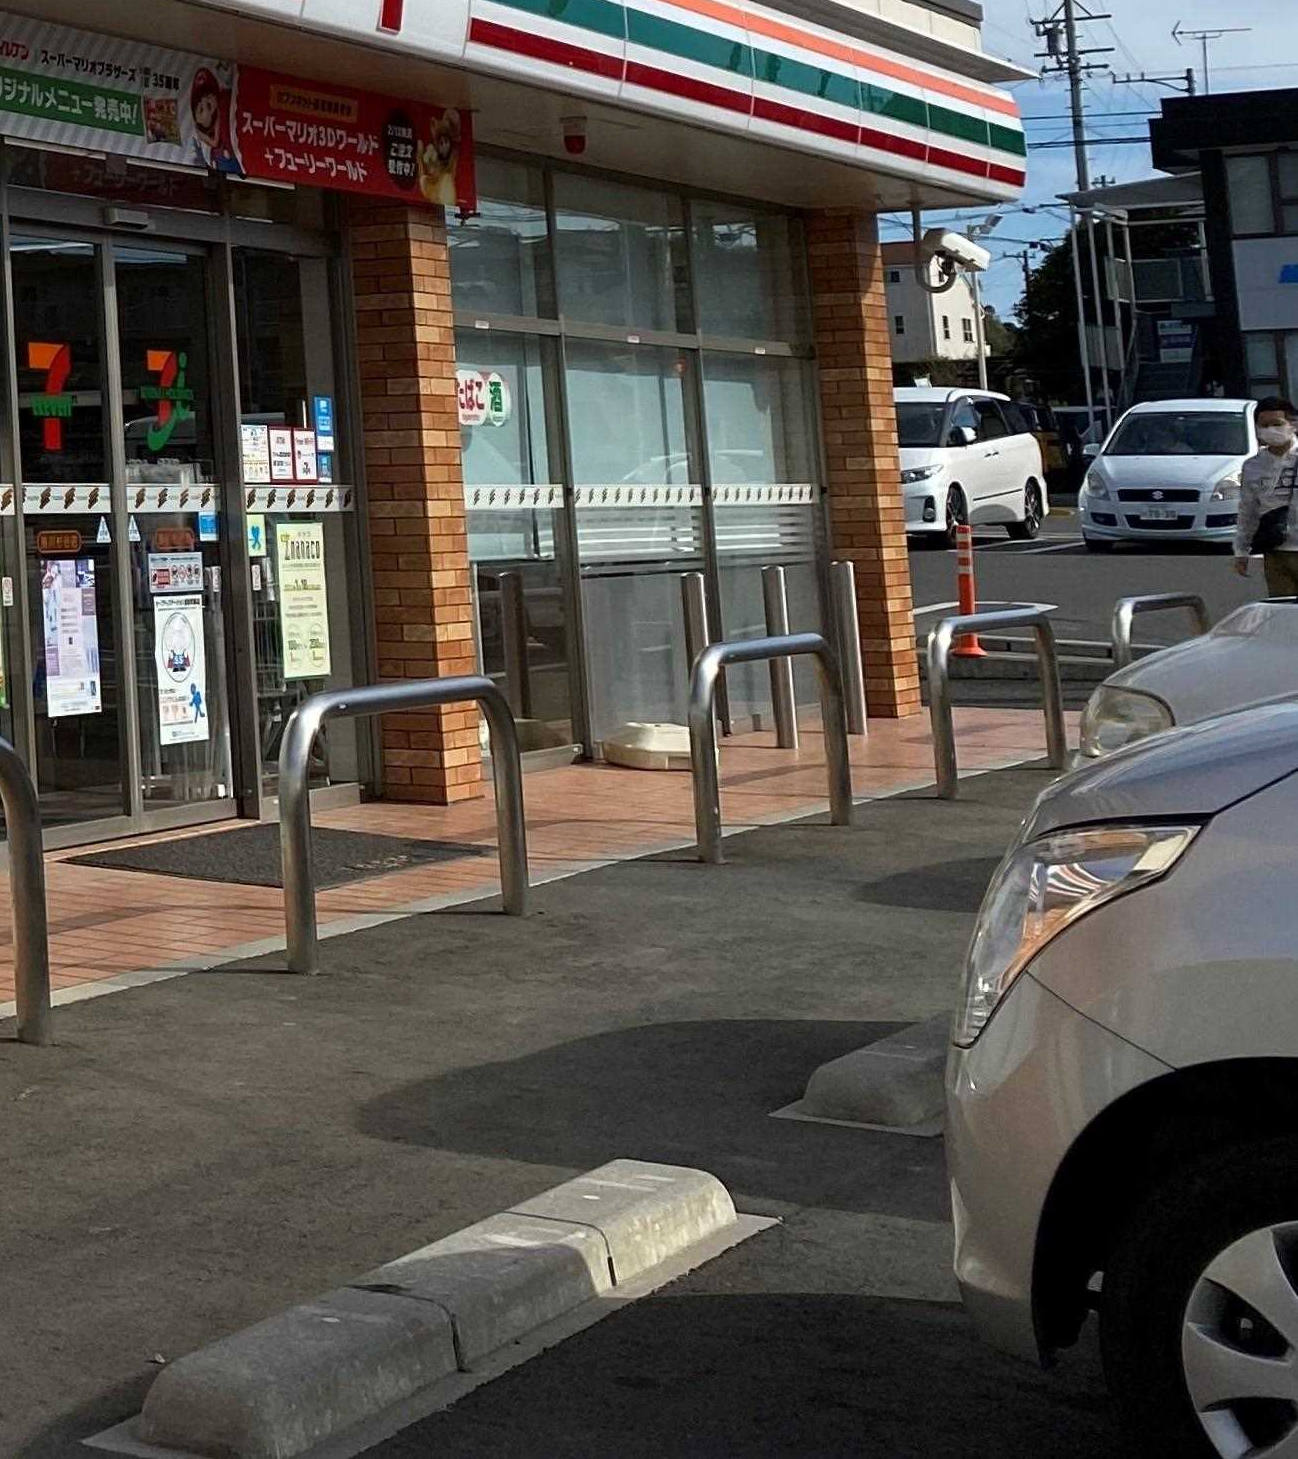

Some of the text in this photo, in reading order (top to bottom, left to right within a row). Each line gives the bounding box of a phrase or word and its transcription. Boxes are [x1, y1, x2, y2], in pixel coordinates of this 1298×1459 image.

[242, 111, 380, 156] スーパーマリオ3Dワールド
[489, 381, 502, 412] 酒
